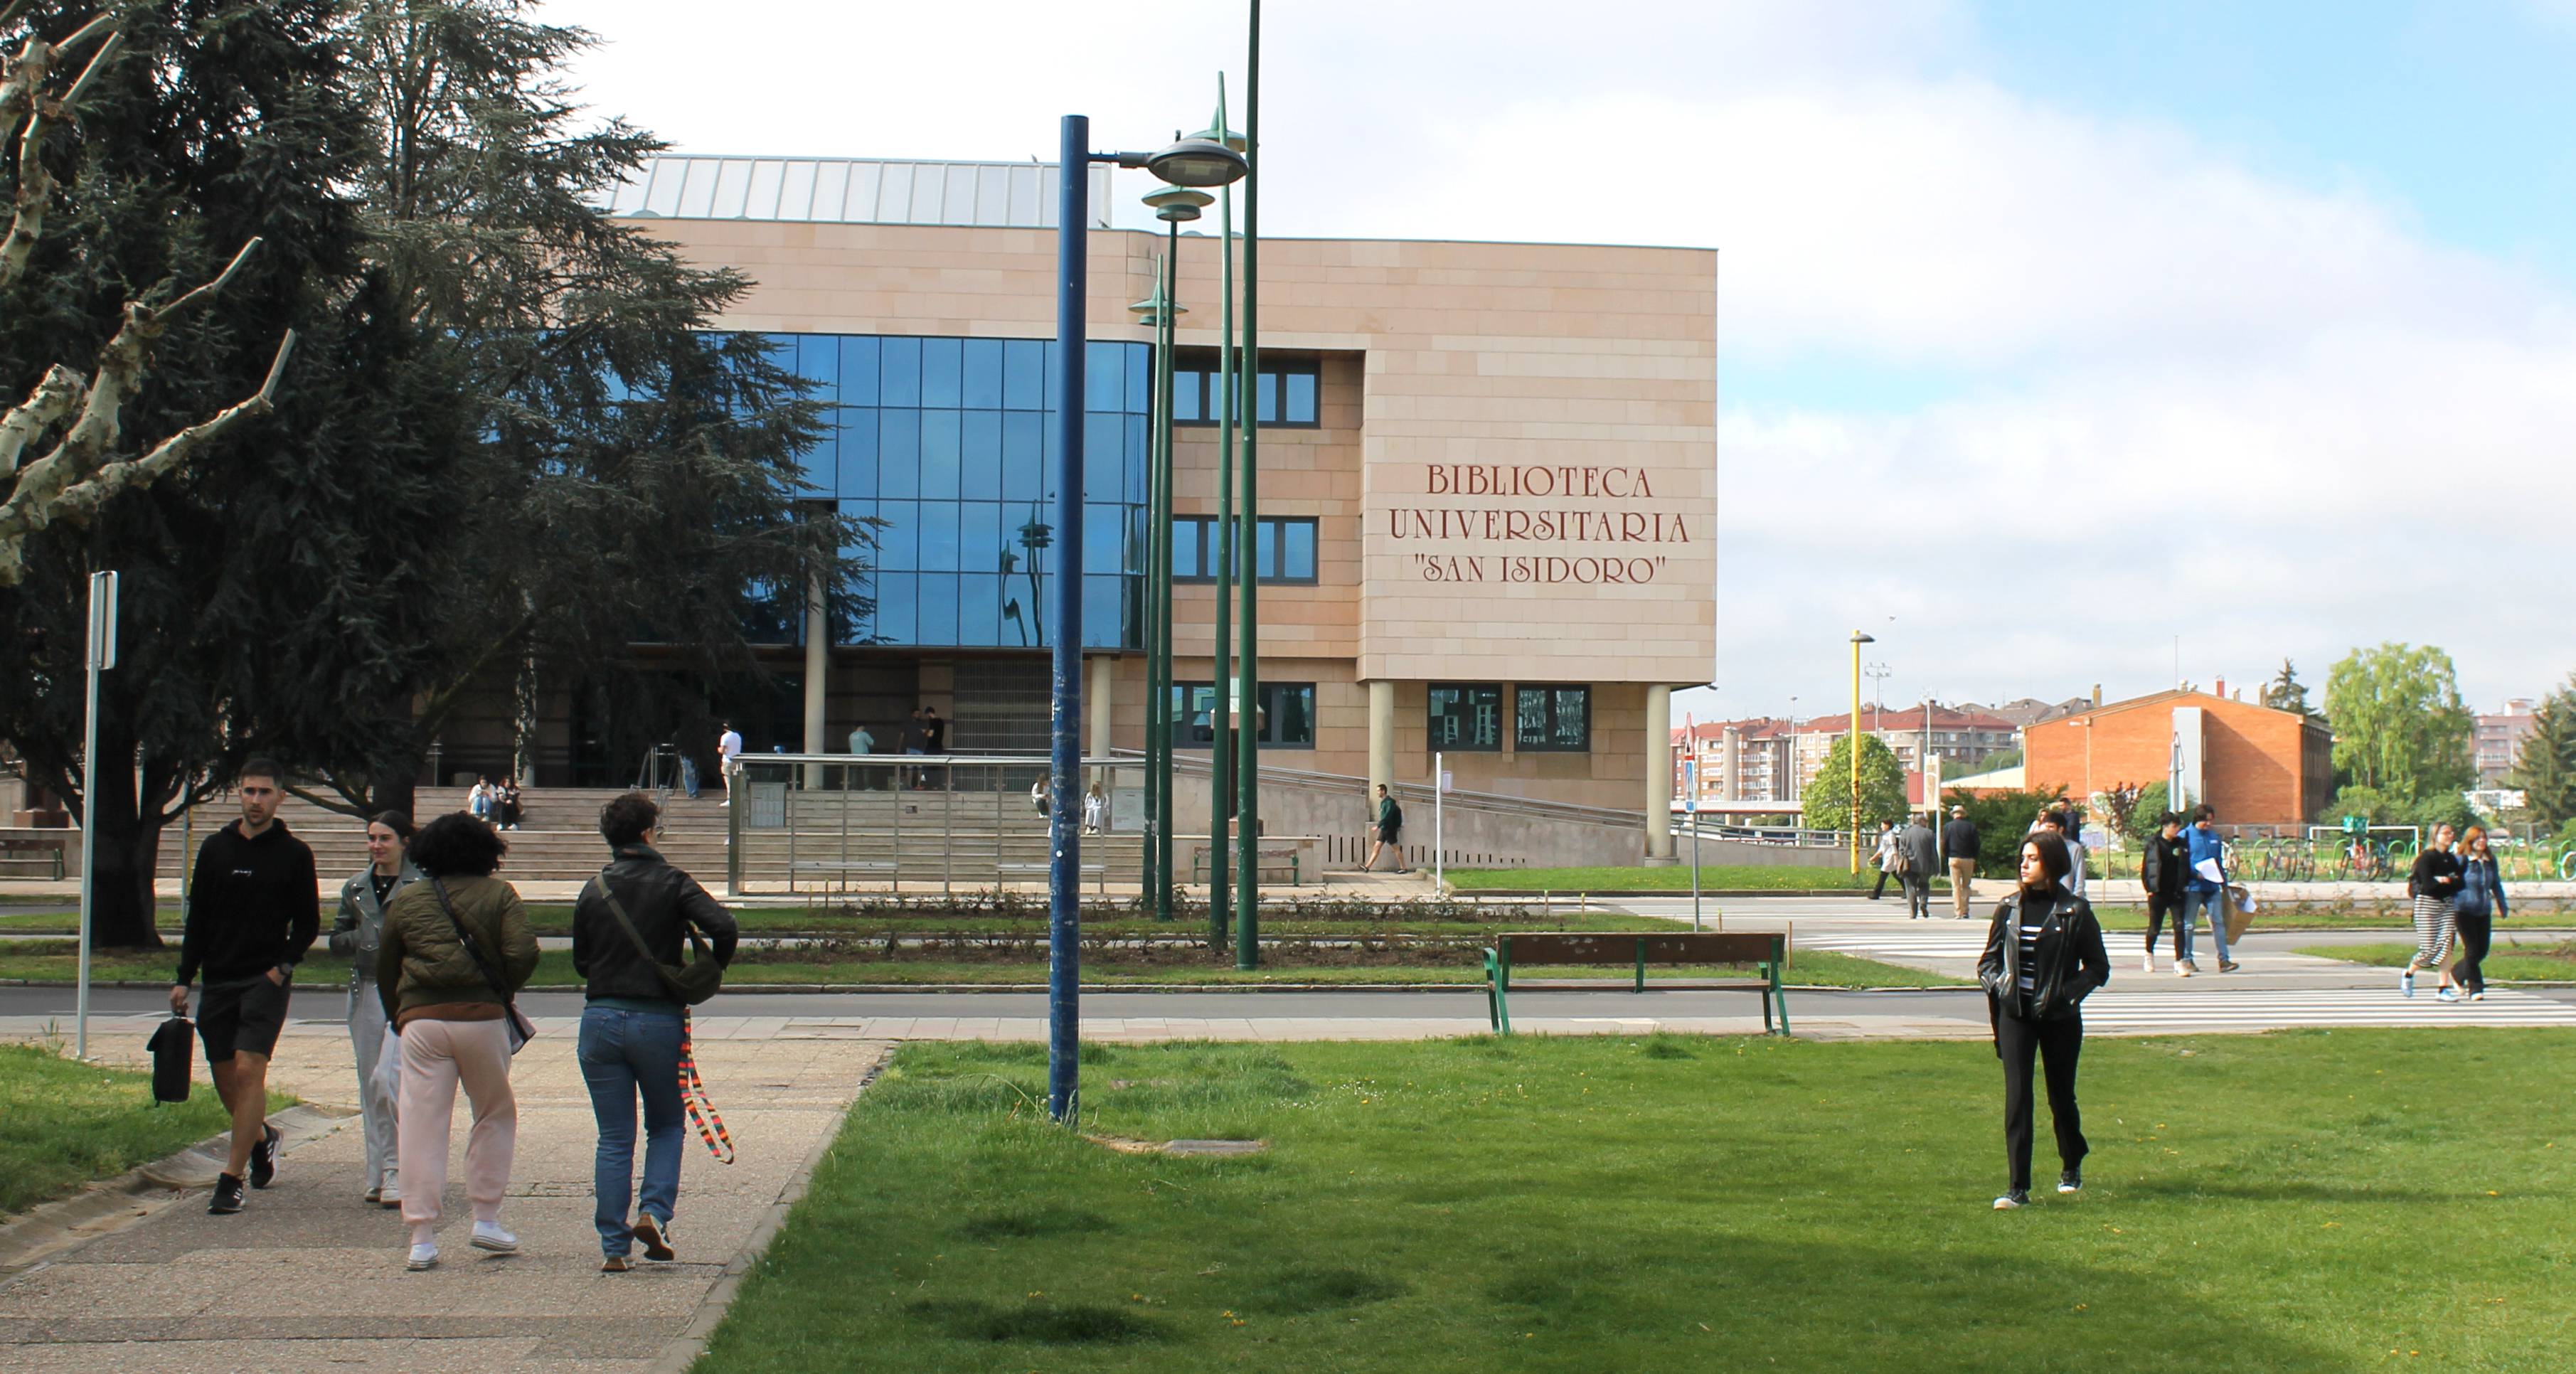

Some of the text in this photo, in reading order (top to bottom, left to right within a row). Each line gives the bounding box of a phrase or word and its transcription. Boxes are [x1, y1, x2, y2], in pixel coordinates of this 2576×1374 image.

[1425, 464, 1654, 498] BIBLIOTECA
[1388, 508, 1690, 543] UNIVERSITARIA
[1415, 553, 1666, 585] "SAN ISIDORO"
